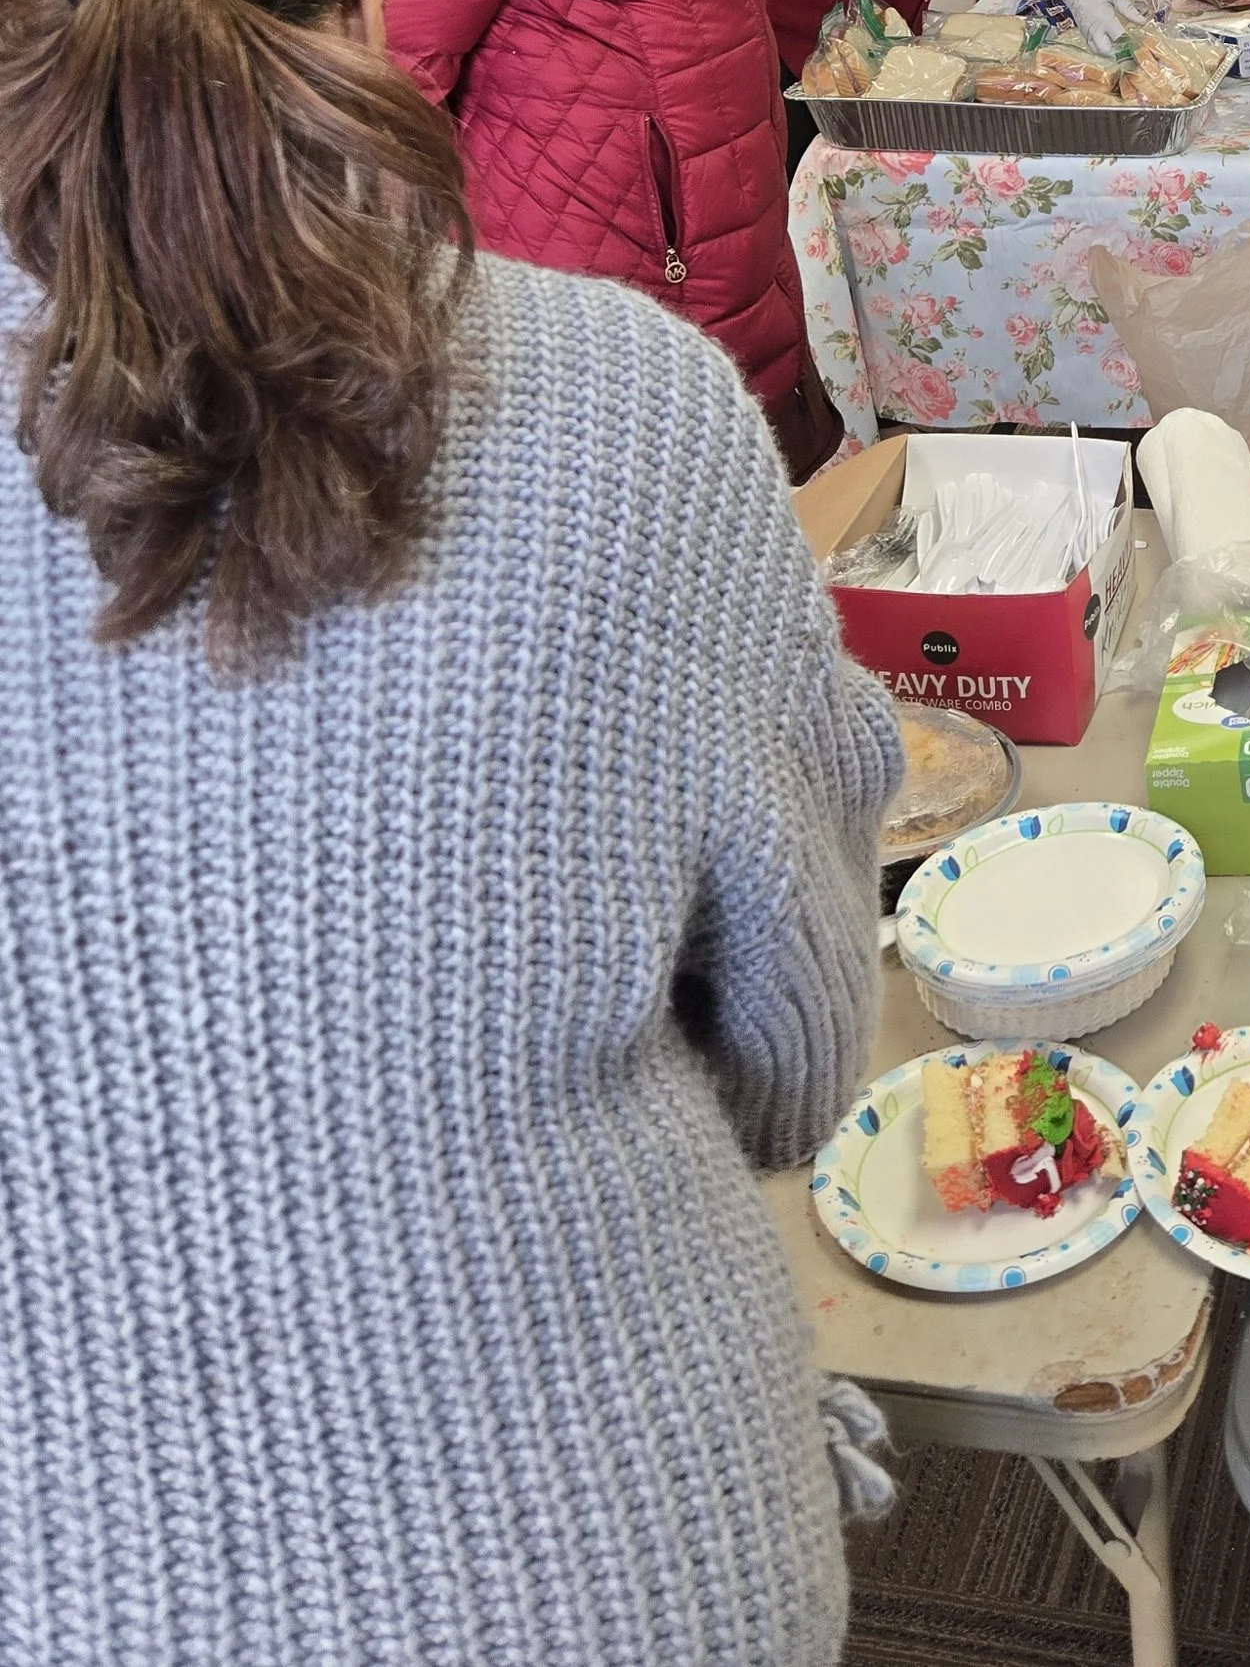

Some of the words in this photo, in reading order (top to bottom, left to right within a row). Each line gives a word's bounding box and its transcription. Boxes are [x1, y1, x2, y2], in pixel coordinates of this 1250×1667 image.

[923, 643, 957, 653] Publix
[869, 670, 947, 697] EAVY
[957, 675, 1031, 699] DUTY
[894, 695, 962, 709] ASTICWARE
[965, 699, 1012, 711] COMBO
[1152, 769, 1185, 779] Zipper
[1153, 779, 1190, 788] Double
